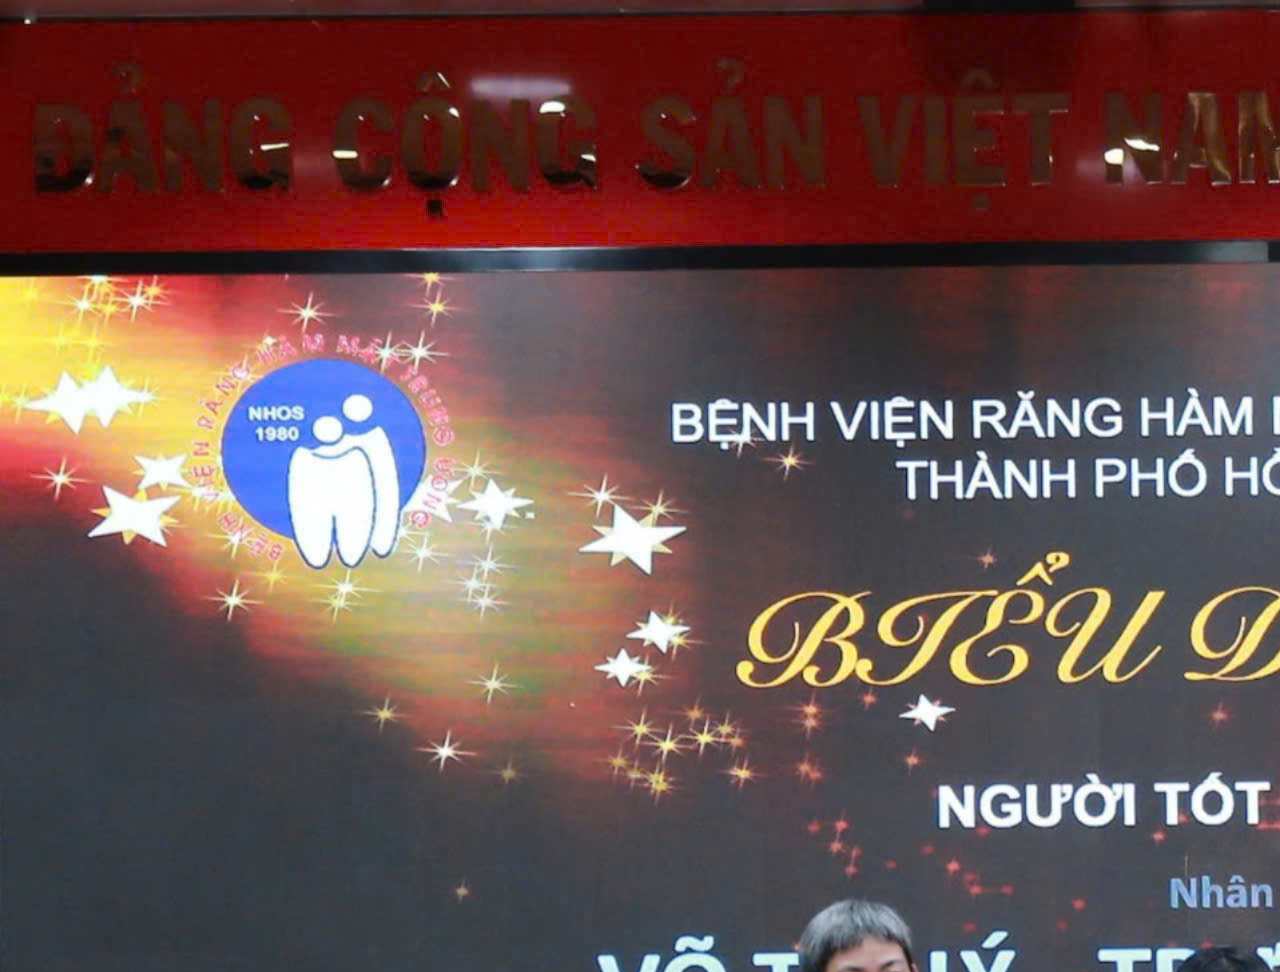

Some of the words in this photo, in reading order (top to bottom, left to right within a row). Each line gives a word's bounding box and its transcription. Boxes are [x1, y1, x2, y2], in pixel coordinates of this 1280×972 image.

[332, 70, 598, 217] CỘNG
[636, 57, 825, 189] SẢN
[860, 68, 1069, 211] VIỆT
[248, 405, 305, 421] NHOS
[255, 426, 300, 442] 1980
[670, 398, 815, 449] BỆNH
[831, 397, 953, 447] VIỆN
[973, 390, 1122, 438] RĂNG
[1141, 388, 1252, 436] HÀM
[896, 451, 1076, 500] THÀNH
[1095, 448, 1208, 498] PHỐ
[736, 552, 1167, 687] BIỂU
[938, 773, 1136, 829] NGƯỜI
[1154, 771, 1271, 826] TỐT
[1170, 875, 1274, 909] Nhân
